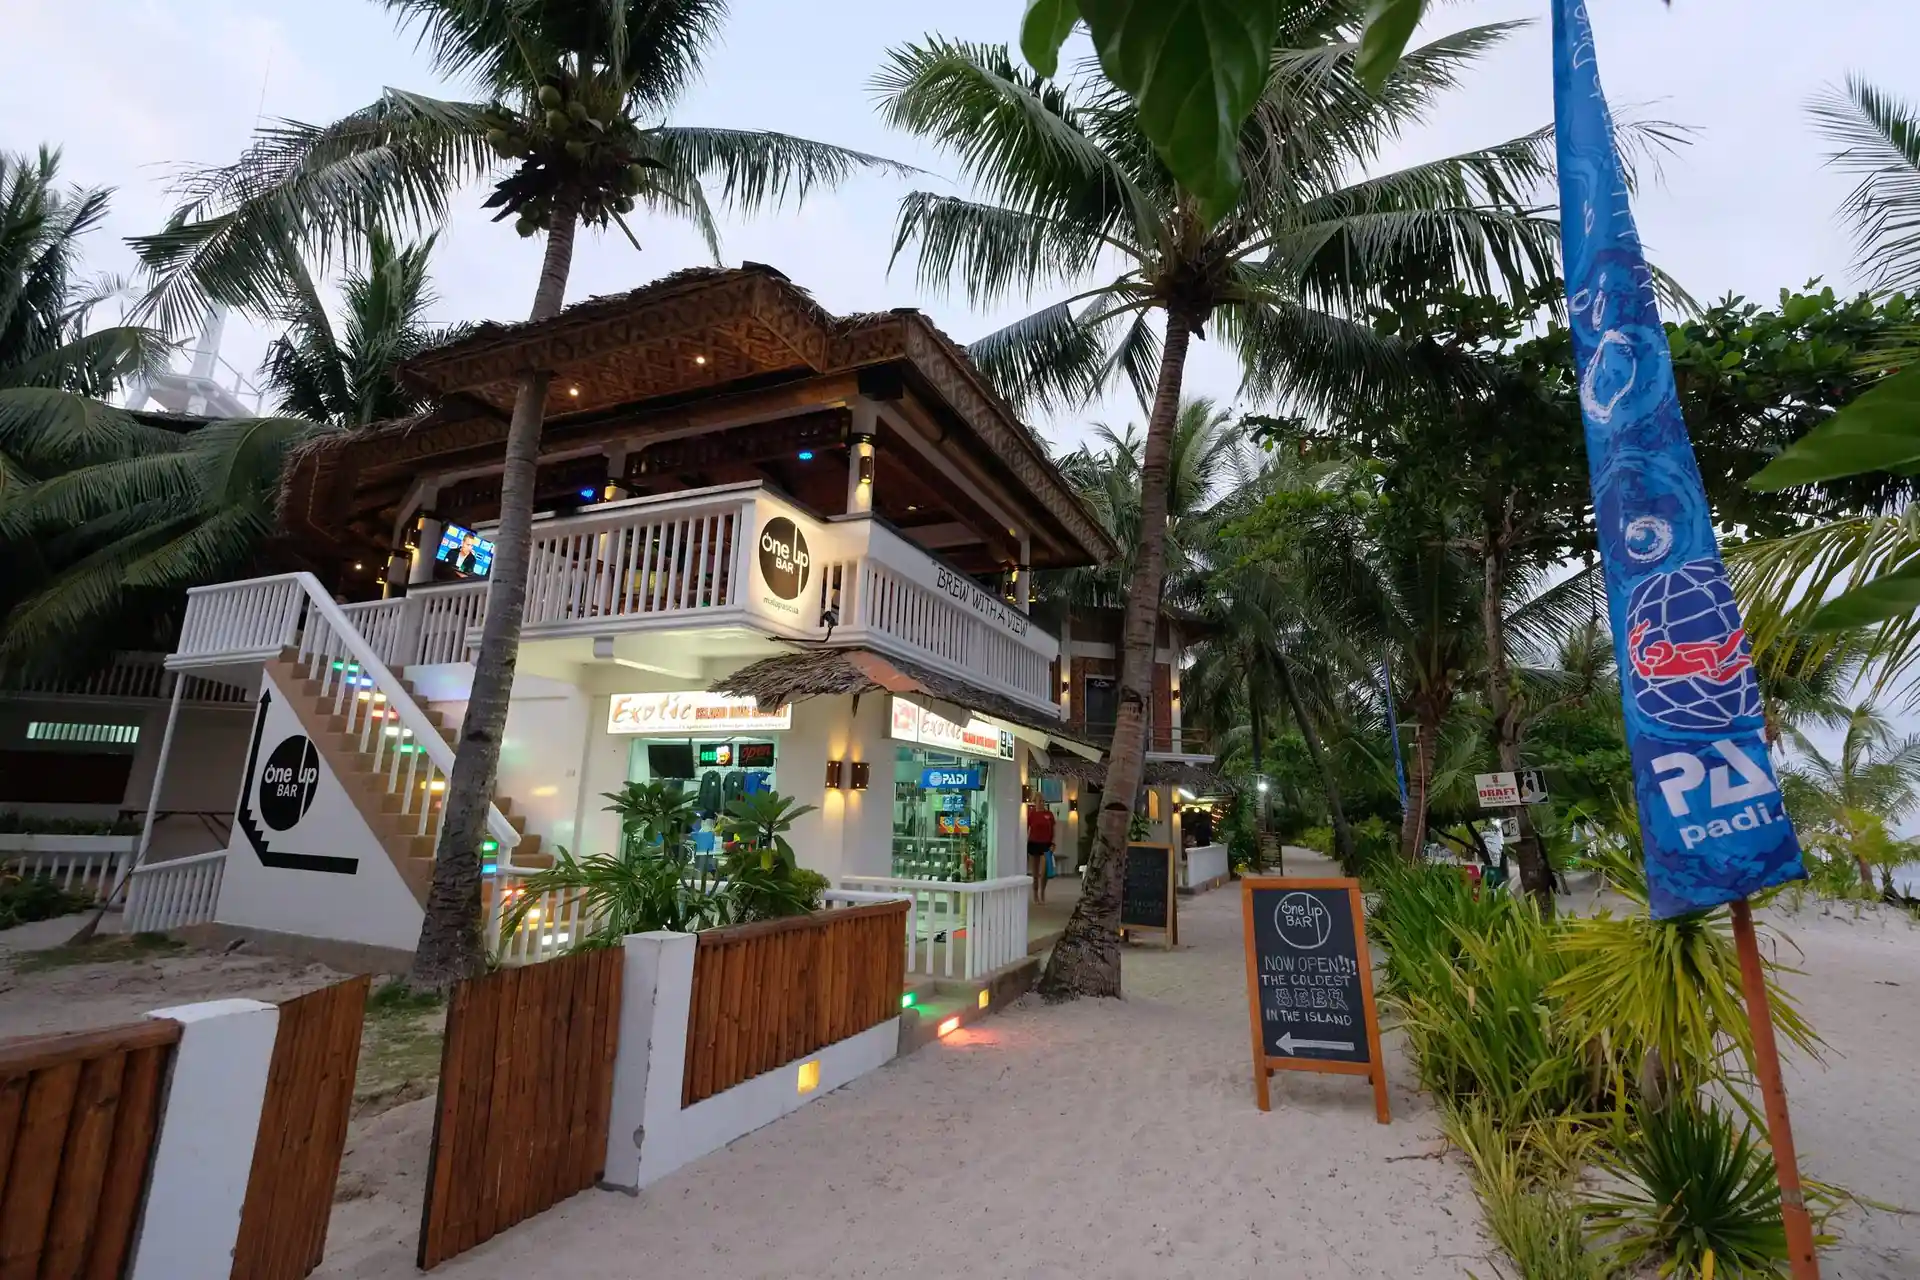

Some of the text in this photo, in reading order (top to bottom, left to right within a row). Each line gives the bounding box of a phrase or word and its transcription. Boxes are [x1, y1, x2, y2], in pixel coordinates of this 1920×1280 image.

[1573, 4, 1596, 70] Dive
[775, 558, 794, 574] BAR
[972, 589, 997, 621] WITH
[997, 608, 1006, 626] A
[611, 695, 692, 724] Exotic
[942, 773, 968, 785] PADI
[1650, 729, 1777, 818] PA
[276, 784, 298, 798] BAR
[1479, 788, 1516, 798] DRAFT
[1679, 802, 1786, 850] padi.
[1286, 916, 1313, 928] BAR
[1264, 955, 1357, 976] NOW OPEN!!!
[1261, 974, 1351, 988] THE COLDEST
[1275, 988, 1349, 1011] BEER
[1265, 1009, 1353, 1027] IN THE ISLAND
